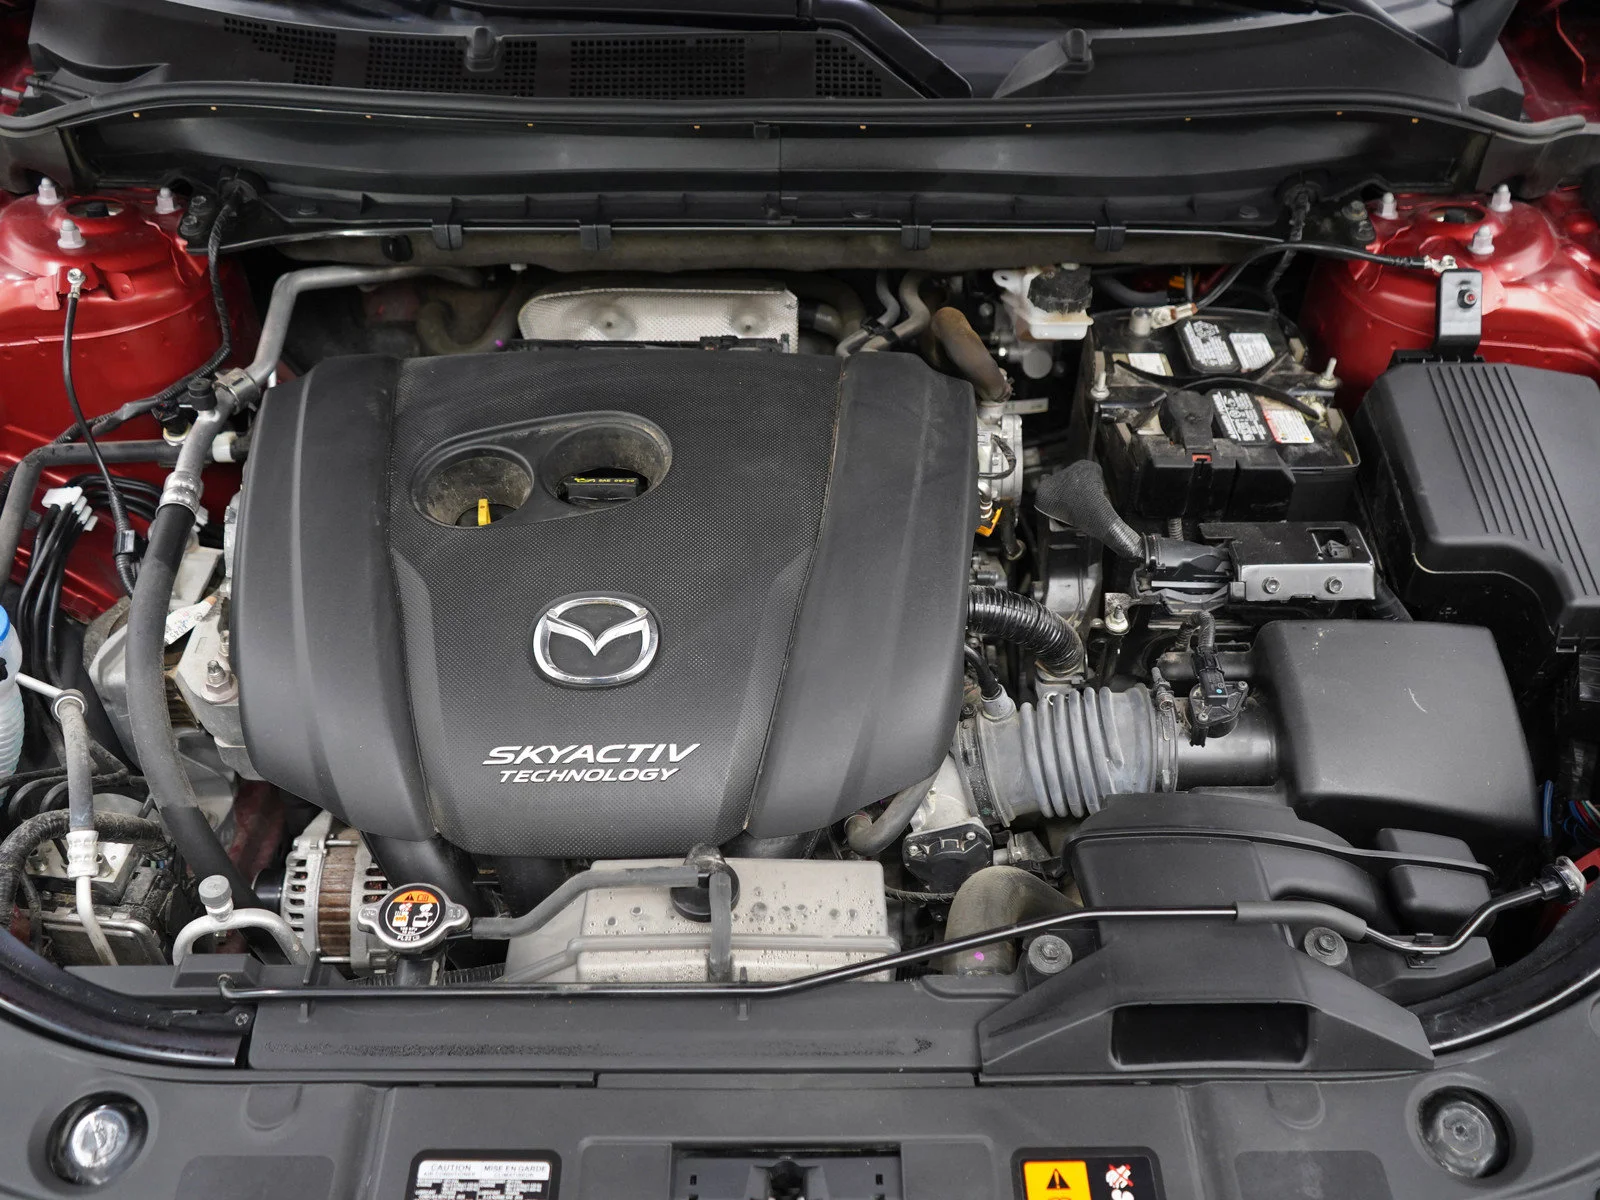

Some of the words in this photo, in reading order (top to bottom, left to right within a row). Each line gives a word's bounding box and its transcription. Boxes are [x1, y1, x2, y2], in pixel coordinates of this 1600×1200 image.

[482, 743, 700, 765] SKYACTIV
[500, 768, 680, 783] TECHNOLOGY
[431, 1164, 472, 1172] CAUTION
